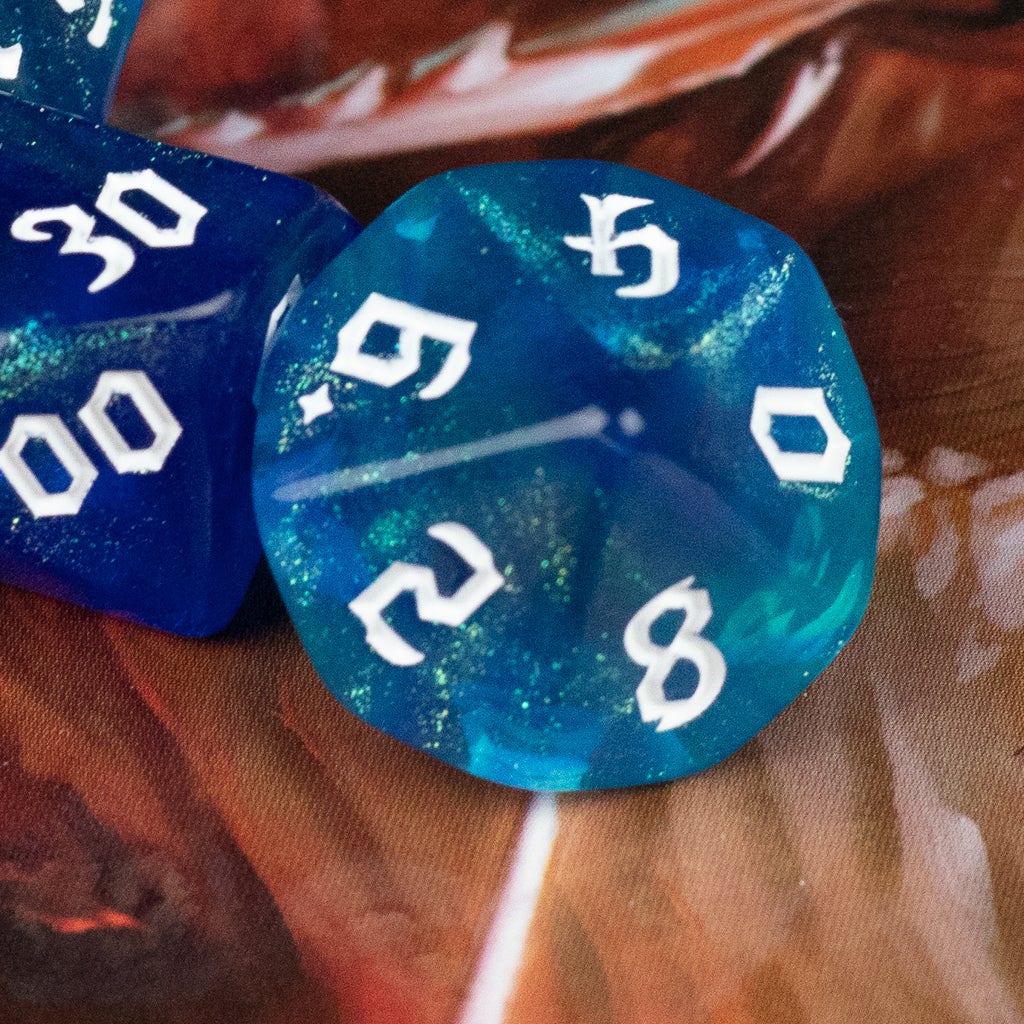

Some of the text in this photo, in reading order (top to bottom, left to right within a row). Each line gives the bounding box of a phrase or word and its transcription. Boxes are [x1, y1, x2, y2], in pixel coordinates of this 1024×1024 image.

[10, 168, 208, 294] 30
[563, 192, 680, 298] 4
[749, 385, 852, 484] 0
[348, 521, 506, 667] 2
[623, 575, 728, 733] 8
